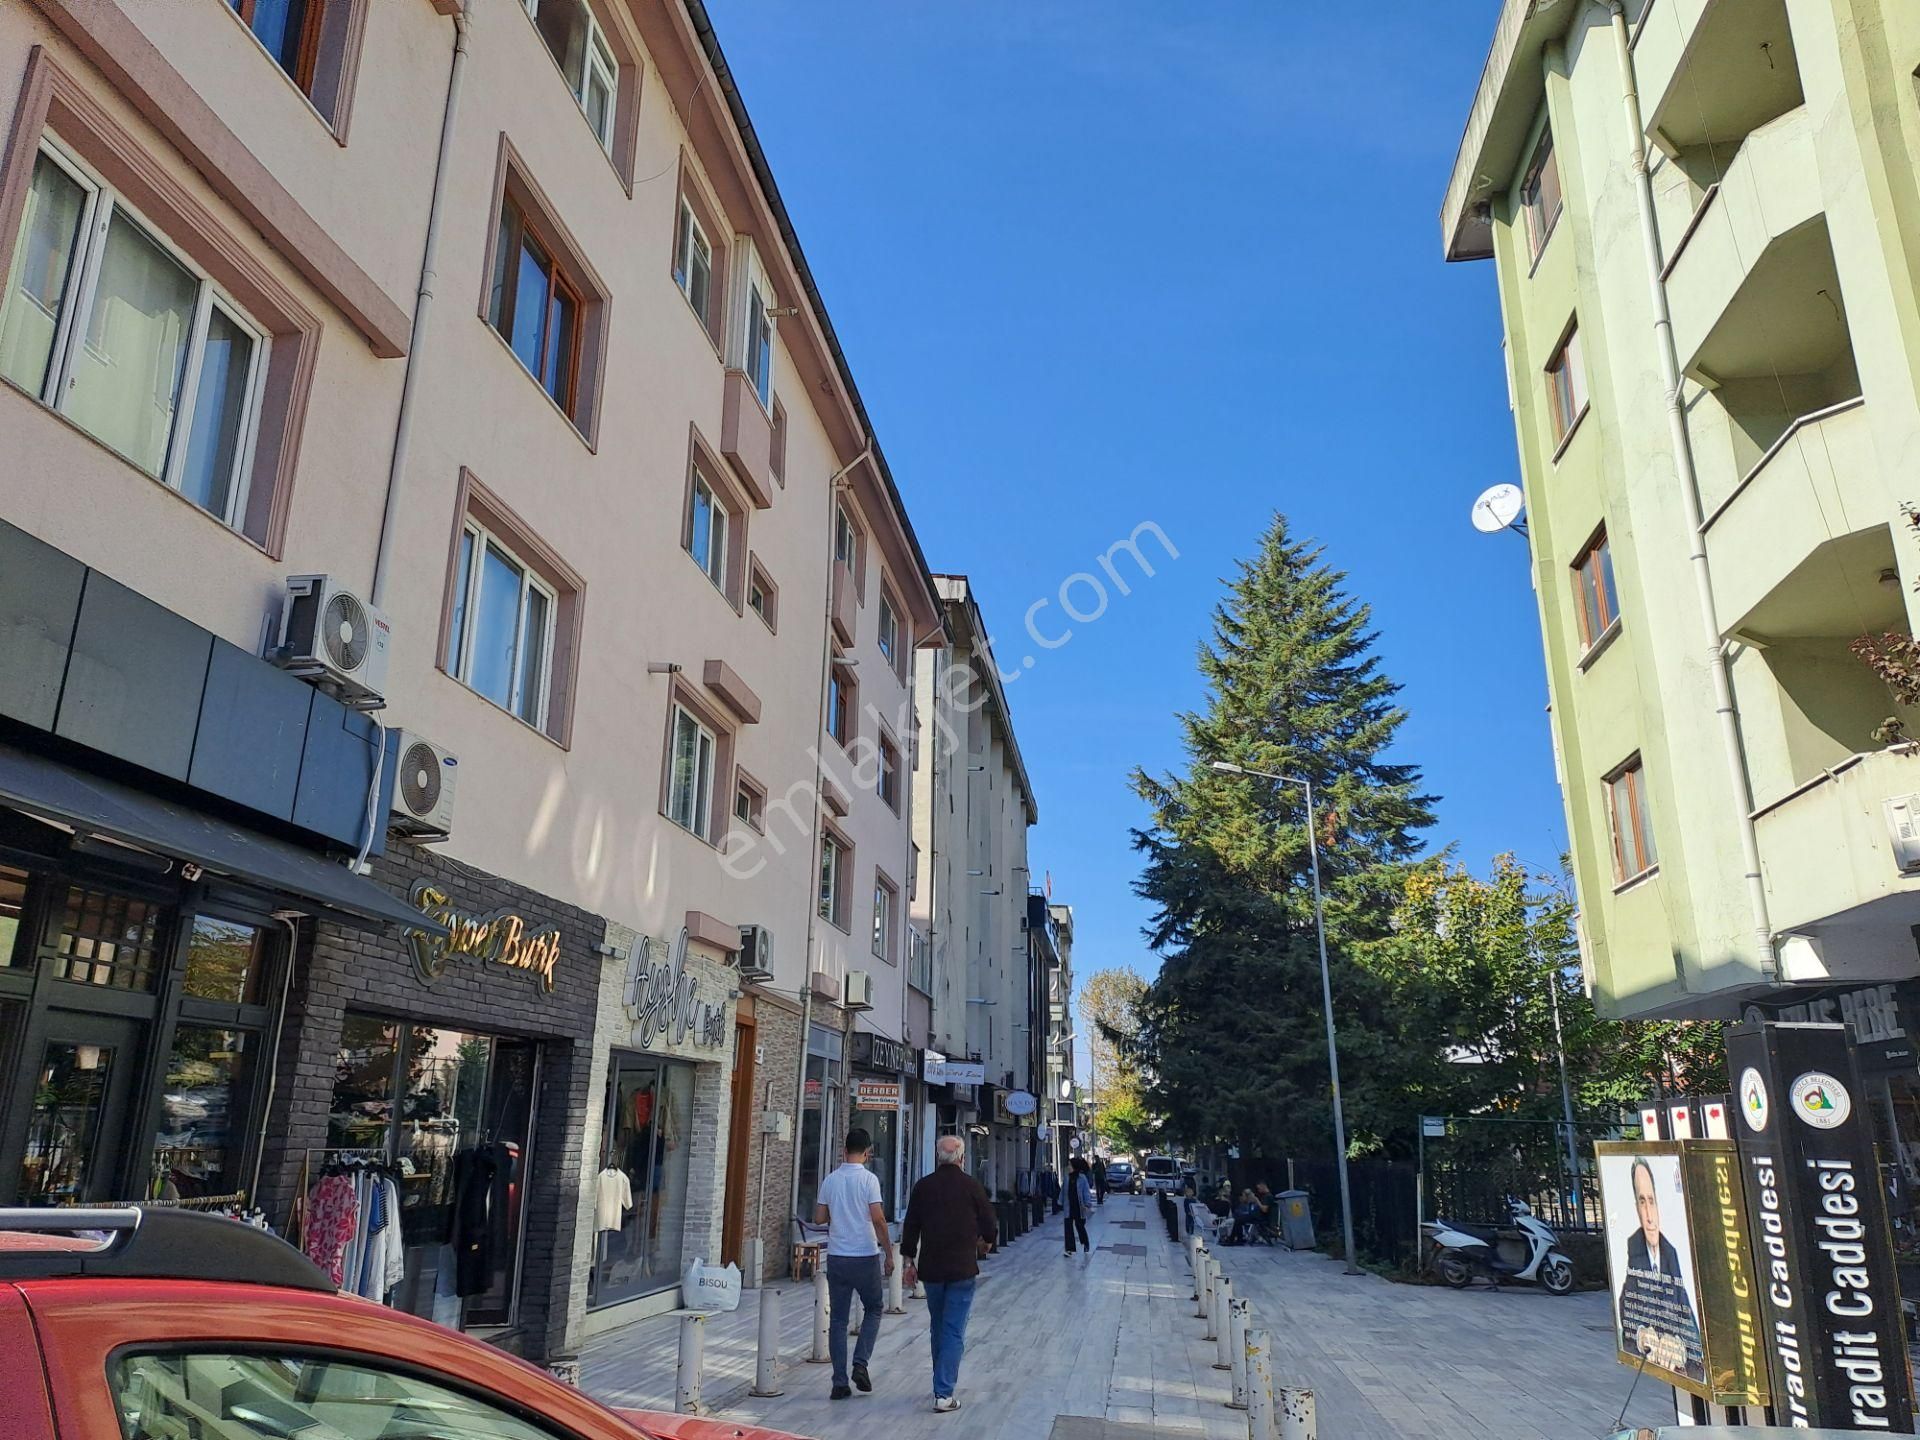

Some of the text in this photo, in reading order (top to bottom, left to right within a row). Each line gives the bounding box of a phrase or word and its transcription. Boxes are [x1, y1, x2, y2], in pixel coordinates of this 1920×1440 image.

[699, 1277, 728, 1289] BISOU
[1752, 1156, 1794, 1309] Caddesi
[1806, 1159, 1874, 1317] Caddesi
